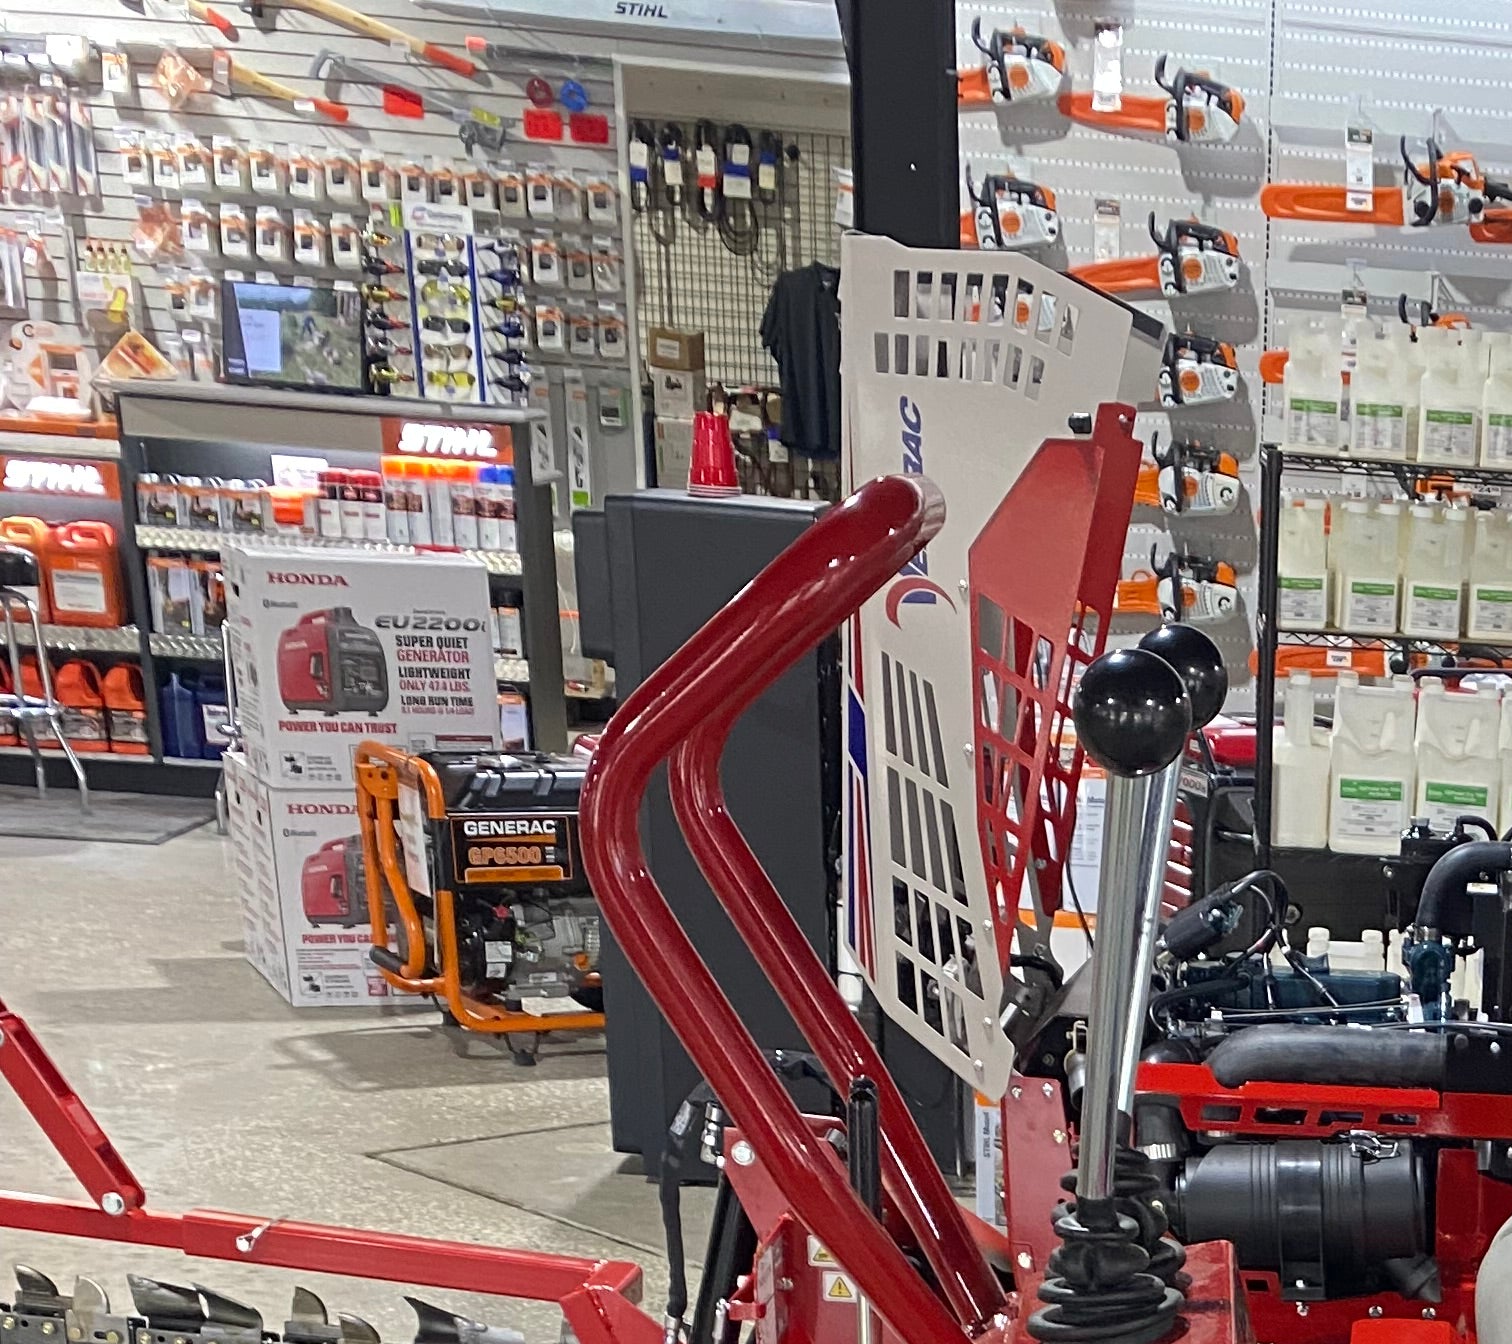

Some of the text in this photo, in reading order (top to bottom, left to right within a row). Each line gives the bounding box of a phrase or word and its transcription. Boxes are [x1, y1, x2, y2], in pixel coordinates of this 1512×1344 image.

[614, 1, 668, 19] STIHL
[397, 422, 498, 458] STIHL
[2, 458, 106, 495] STIHL
[266, 571, 349, 588] HONDA
[375, 615, 486, 633] EU2200i
[395, 635, 469, 650] SUPER QUIET
[396, 649, 469, 663] GENERATOR
[398, 666, 471, 680] LIGHTWEIGHT
[399, 680, 426, 692] ONLY
[401, 694, 474, 707] LONG RUN TIME
[279, 719, 397, 735] POWER YOU CAN TRUST
[463, 819, 556, 837] GENERAC
[468, 846, 541, 865] GP6500
